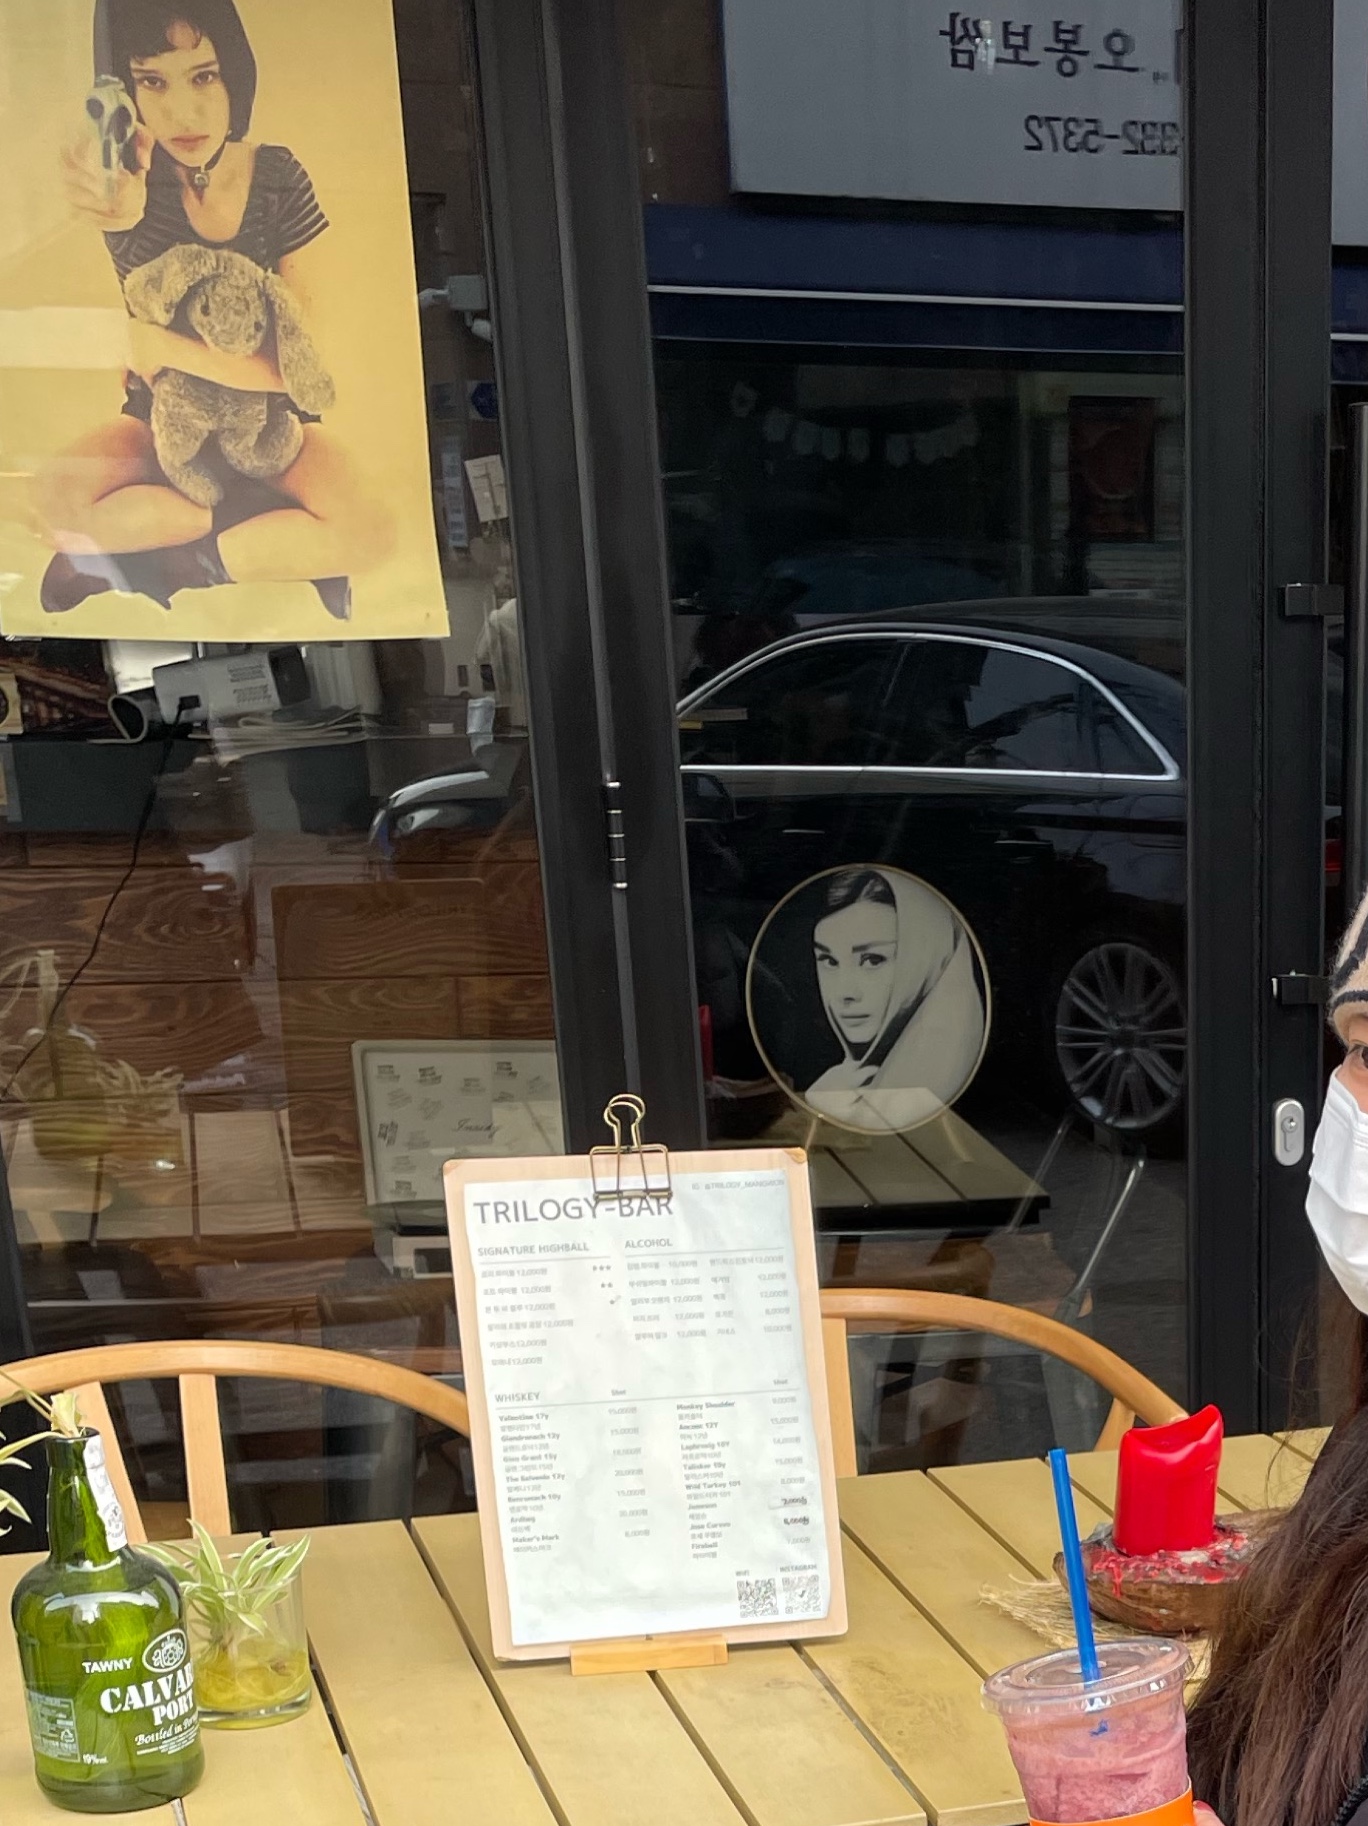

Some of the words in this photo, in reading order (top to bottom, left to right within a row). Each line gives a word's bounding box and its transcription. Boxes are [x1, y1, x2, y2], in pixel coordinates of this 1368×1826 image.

[473, 1196, 673, 1224] TRILOGY-BAR
[478, 1244, 536, 1257] SIGNATURE
[538, 1242, 590, 1254] HIGHBALL
[624, 1238, 673, 1249] ALCOHOL
[494, 1392, 541, 1403] WHISKEY
[81, 1657, 133, 1674] TAWNY
[134, 1723, 174, 1746] Bottled
